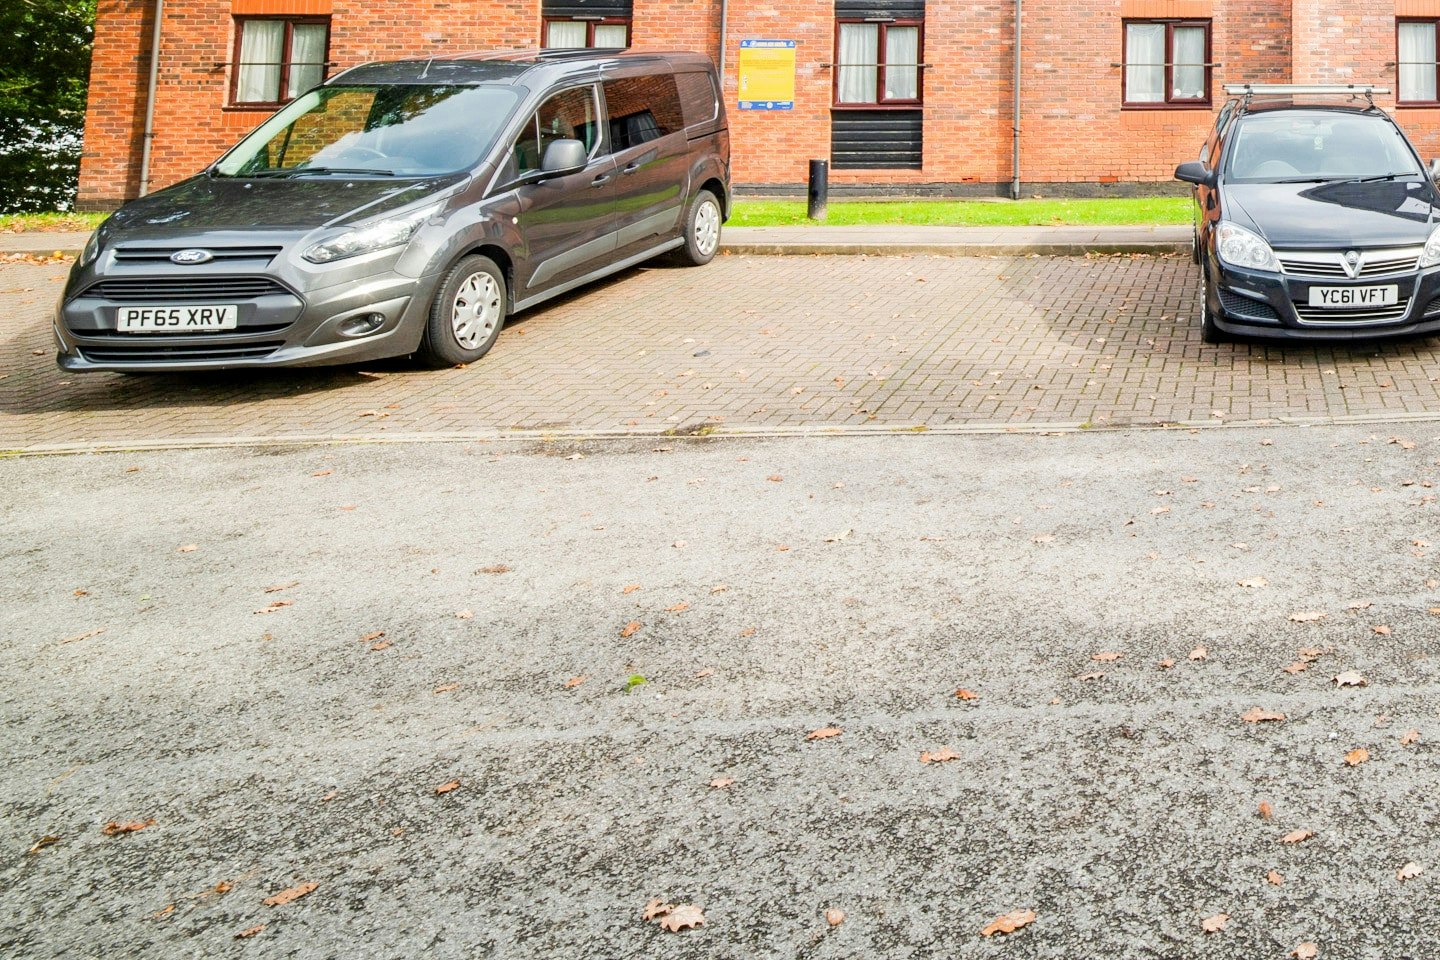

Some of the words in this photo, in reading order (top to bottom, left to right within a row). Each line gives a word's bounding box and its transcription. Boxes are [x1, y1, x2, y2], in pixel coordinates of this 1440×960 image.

[1320, 289, 1356, 304] YC61
[1360, 288, 1389, 303] VFT
[127, 309, 180, 327] PF65
[187, 308, 227, 325] XRV
